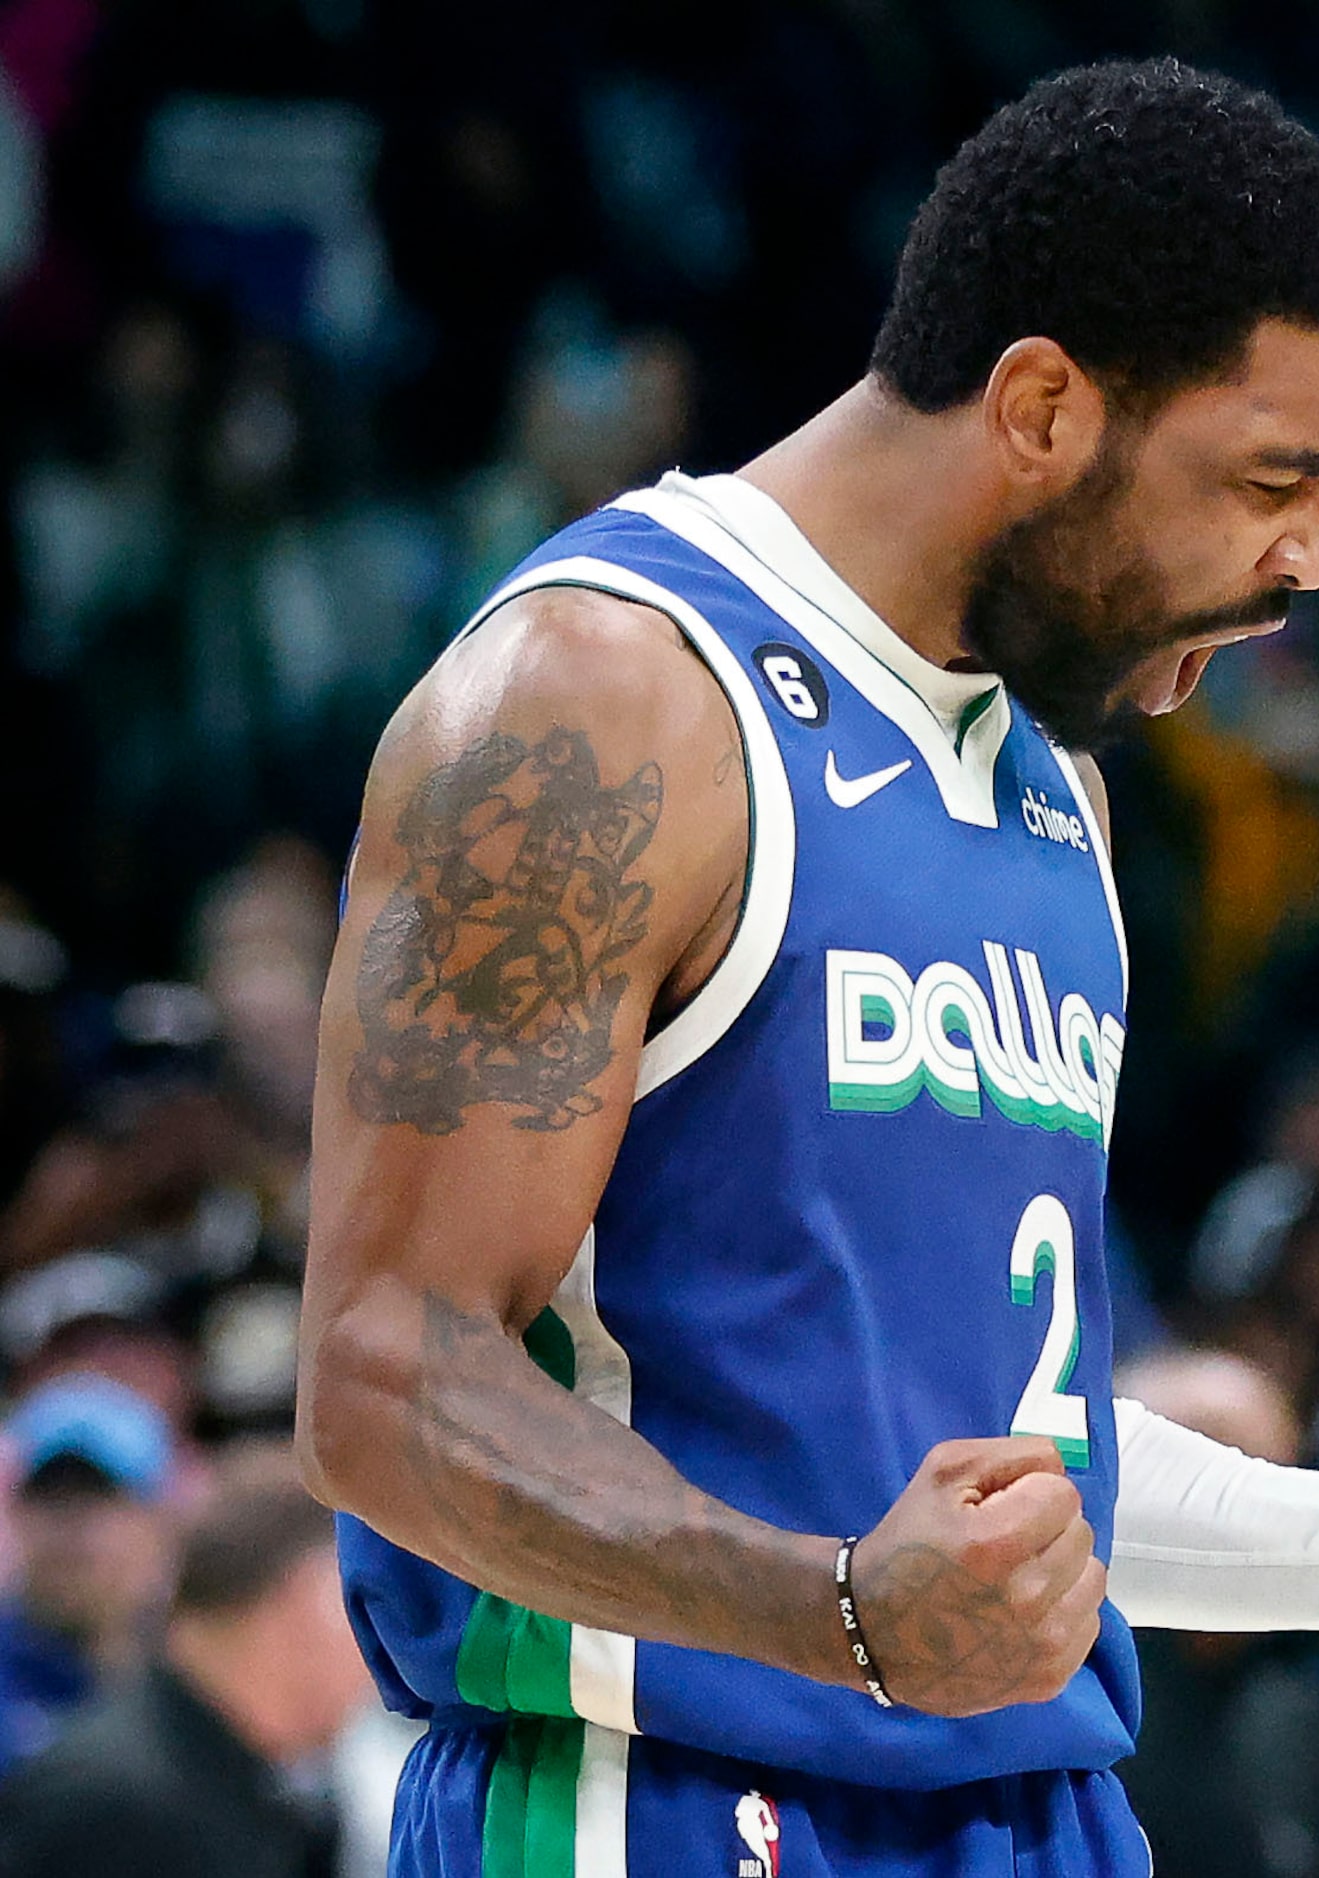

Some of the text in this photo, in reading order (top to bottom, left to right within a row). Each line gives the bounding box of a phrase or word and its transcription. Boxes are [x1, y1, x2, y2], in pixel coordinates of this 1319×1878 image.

[763, 656, 819, 719] 6
[1021, 786, 1089, 853] chime
[1010, 1193, 1090, 1469] 2
[739, 1859, 763, 1878] NBA
